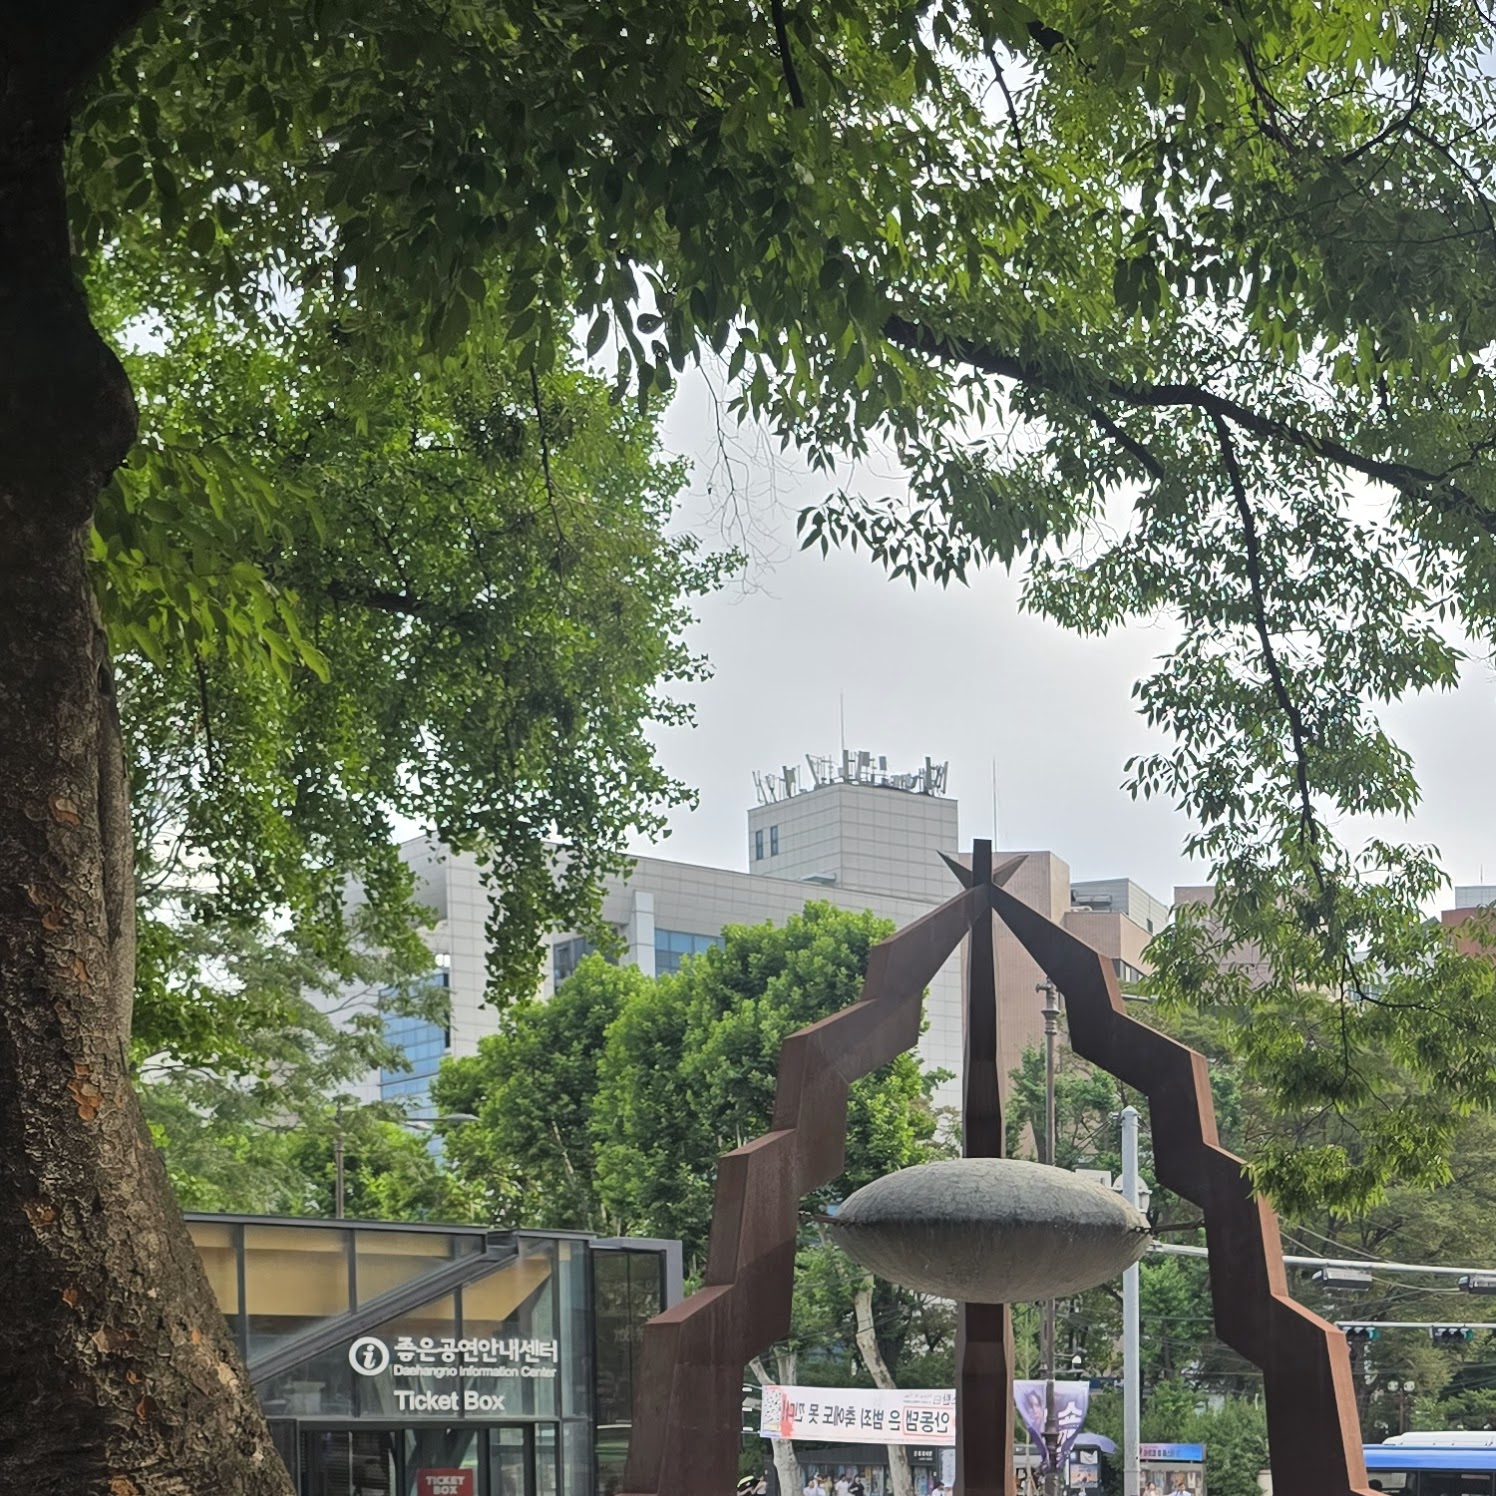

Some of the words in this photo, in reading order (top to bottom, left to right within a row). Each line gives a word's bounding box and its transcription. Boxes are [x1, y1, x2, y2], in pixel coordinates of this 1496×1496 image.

[459, 1365, 519, 1377] Information
[520, 1365, 557, 1378] Center
[393, 1390, 460, 1411] Ticket
[463, 1390, 505, 1411] Box
[425, 1475, 466, 1486] TICKET
[433, 1485, 459, 1495] BOX
